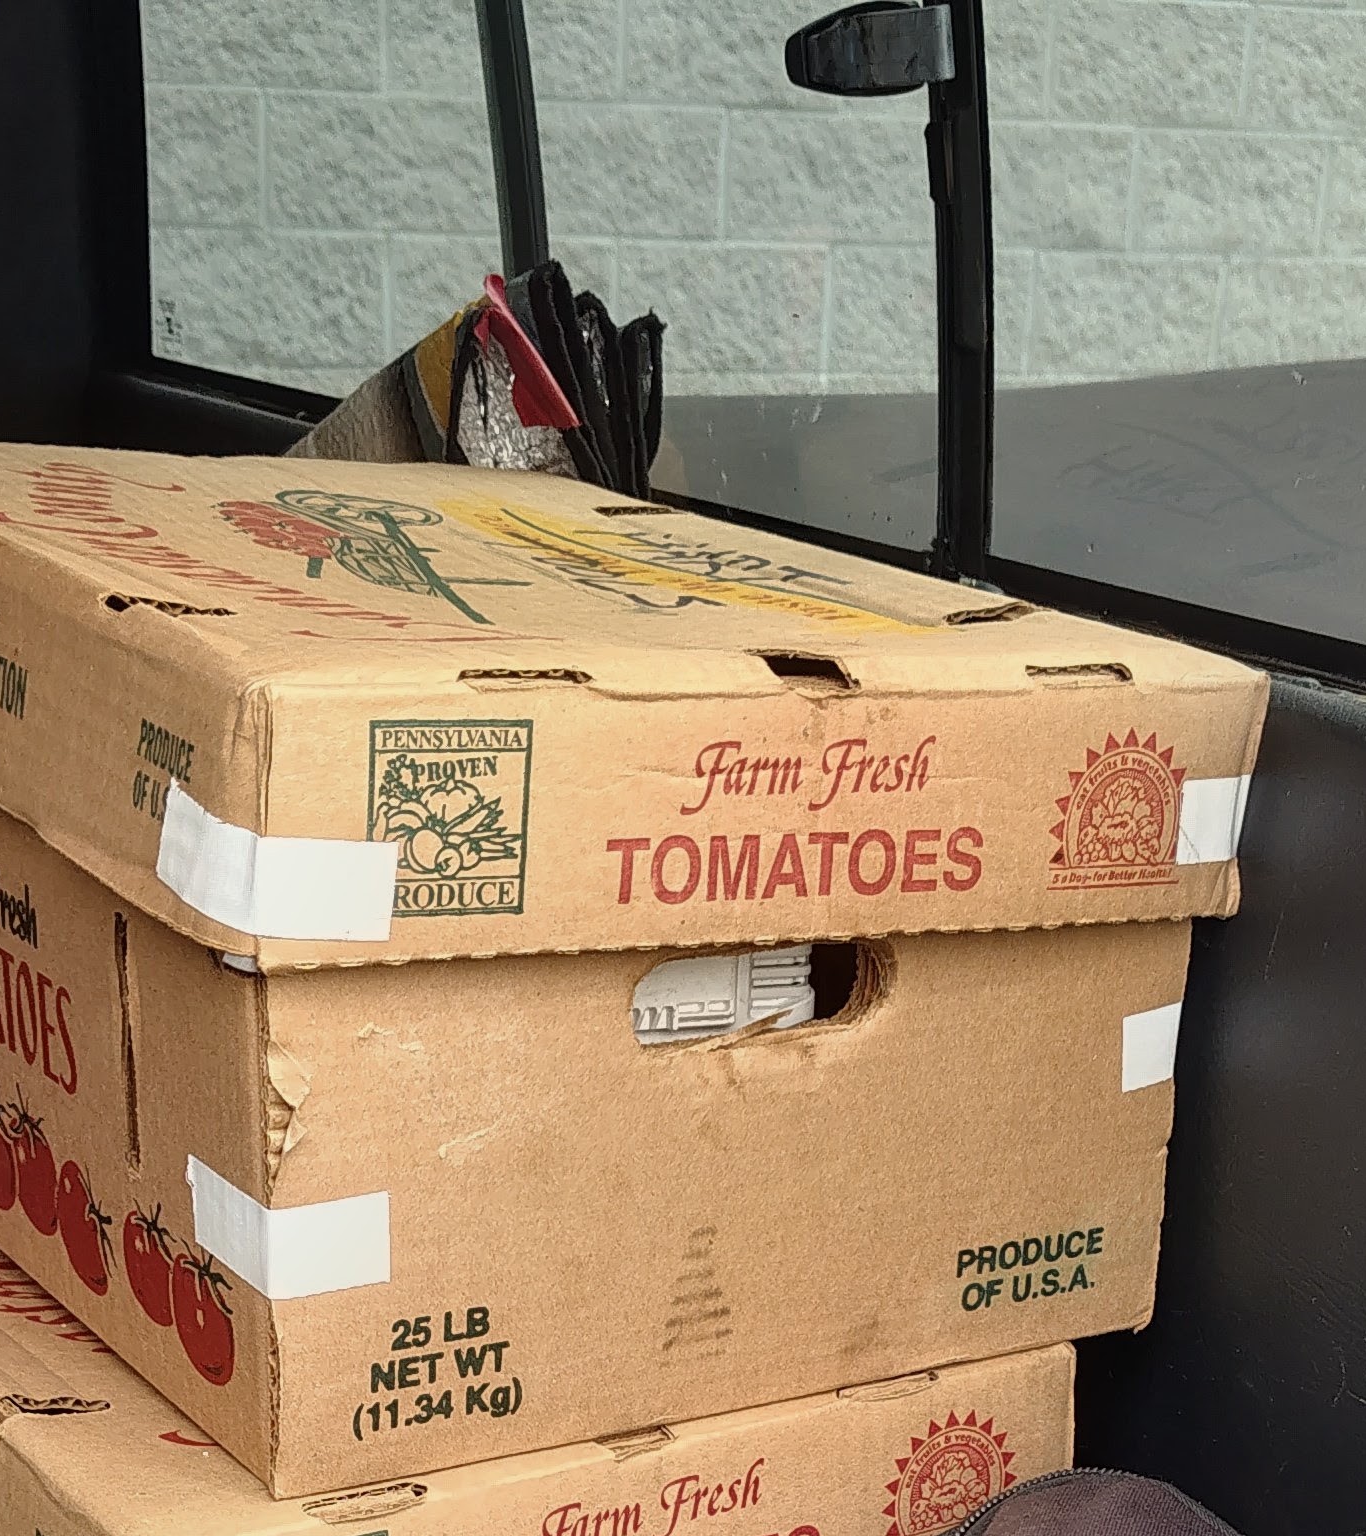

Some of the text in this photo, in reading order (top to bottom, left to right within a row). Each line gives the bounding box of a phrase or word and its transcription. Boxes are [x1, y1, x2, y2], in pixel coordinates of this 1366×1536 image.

[137, 717, 195, 784] PRODUCE
[381, 729, 523, 749] PENNSYLVANIA
[414, 755, 499, 783] PROVEN
[679, 735, 937, 816] Farm Fresh
[606, 826, 984, 905] TOMATOES
[1108, 869, 1136, 881] Better
[393, 880, 515, 909] RODUCE
[956, 1226, 1105, 1279] PRODUCE
[961, 1263, 1095, 1312] OF U.S.A.
[391, 1306, 490, 1351] 25 LB
[370, 1340, 511, 1394] NET WT
[352, 1376, 523, 1442] (11.34 Kg)
[905, 1468, 917, 1489] eat
[915, 1441, 941, 1467] fruits
[954, 1434, 996, 1467] vegetables
